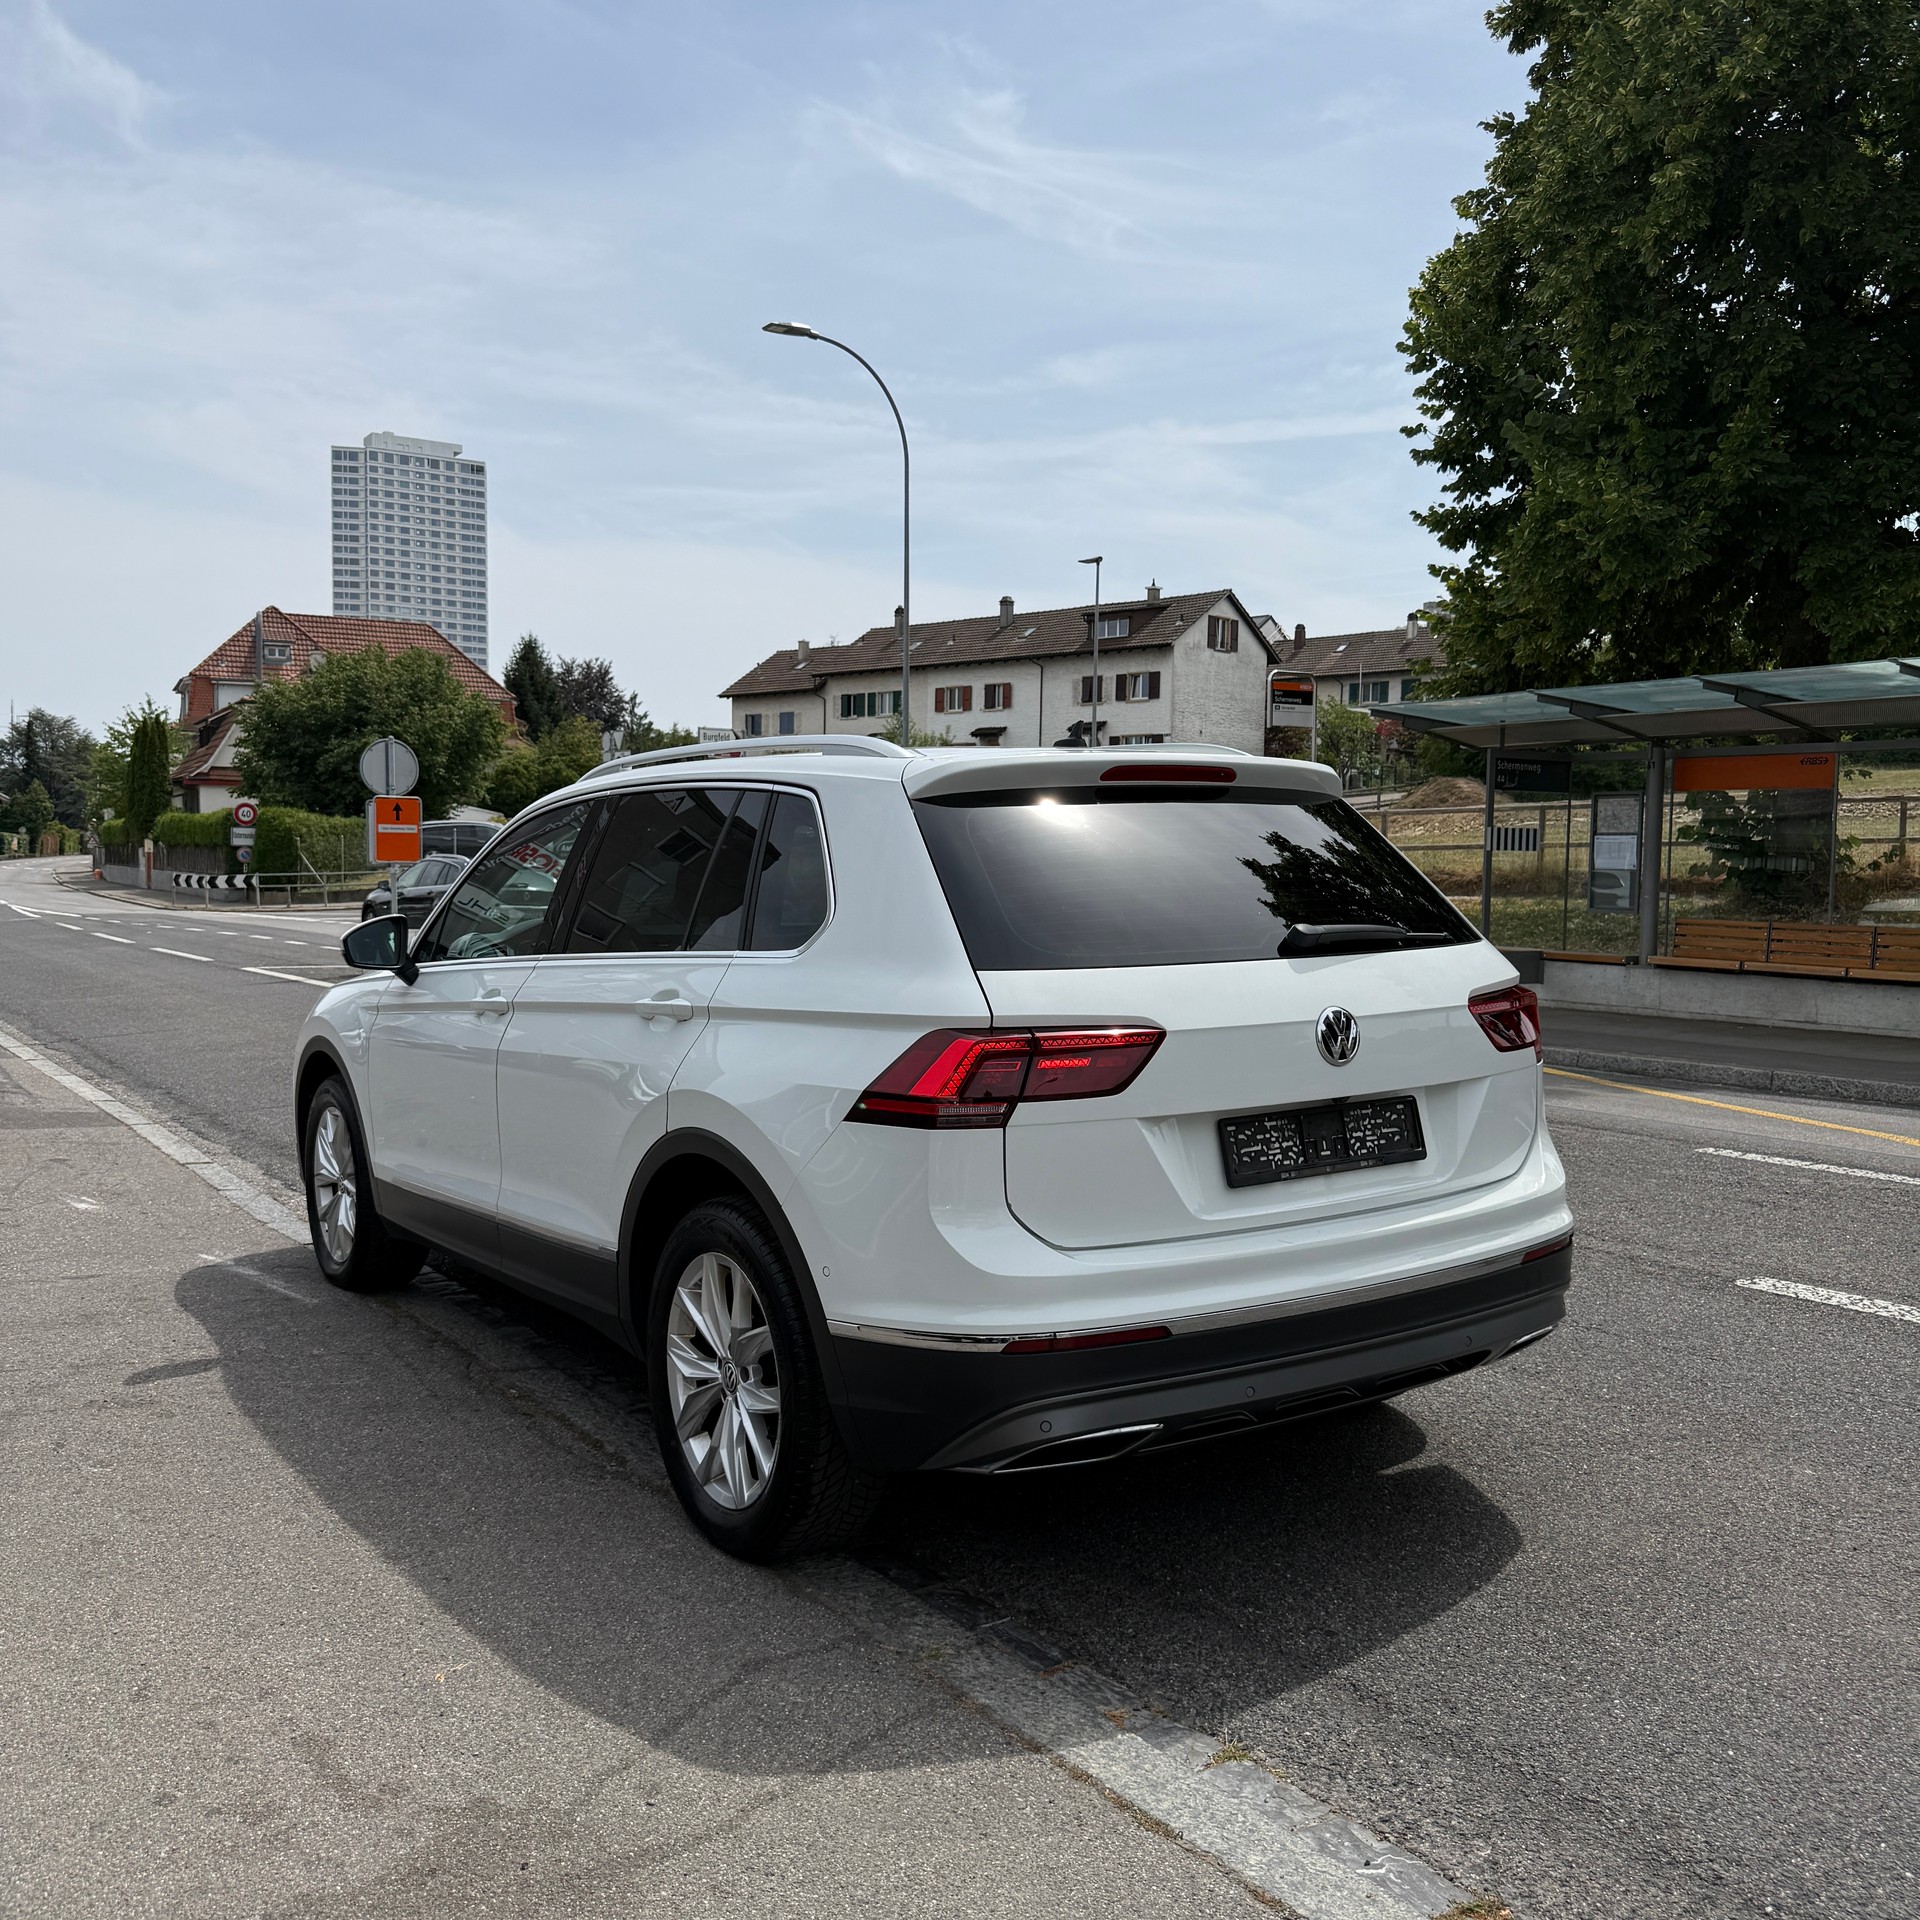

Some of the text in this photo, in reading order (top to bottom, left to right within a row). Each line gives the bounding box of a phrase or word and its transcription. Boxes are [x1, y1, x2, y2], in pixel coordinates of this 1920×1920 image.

[703, 732, 731, 742] Burgfeld
[1497, 760, 1541, 774] Schermenweg
[241, 810, 251, 818] 40
[1316, 1006, 1360, 1066] VW
